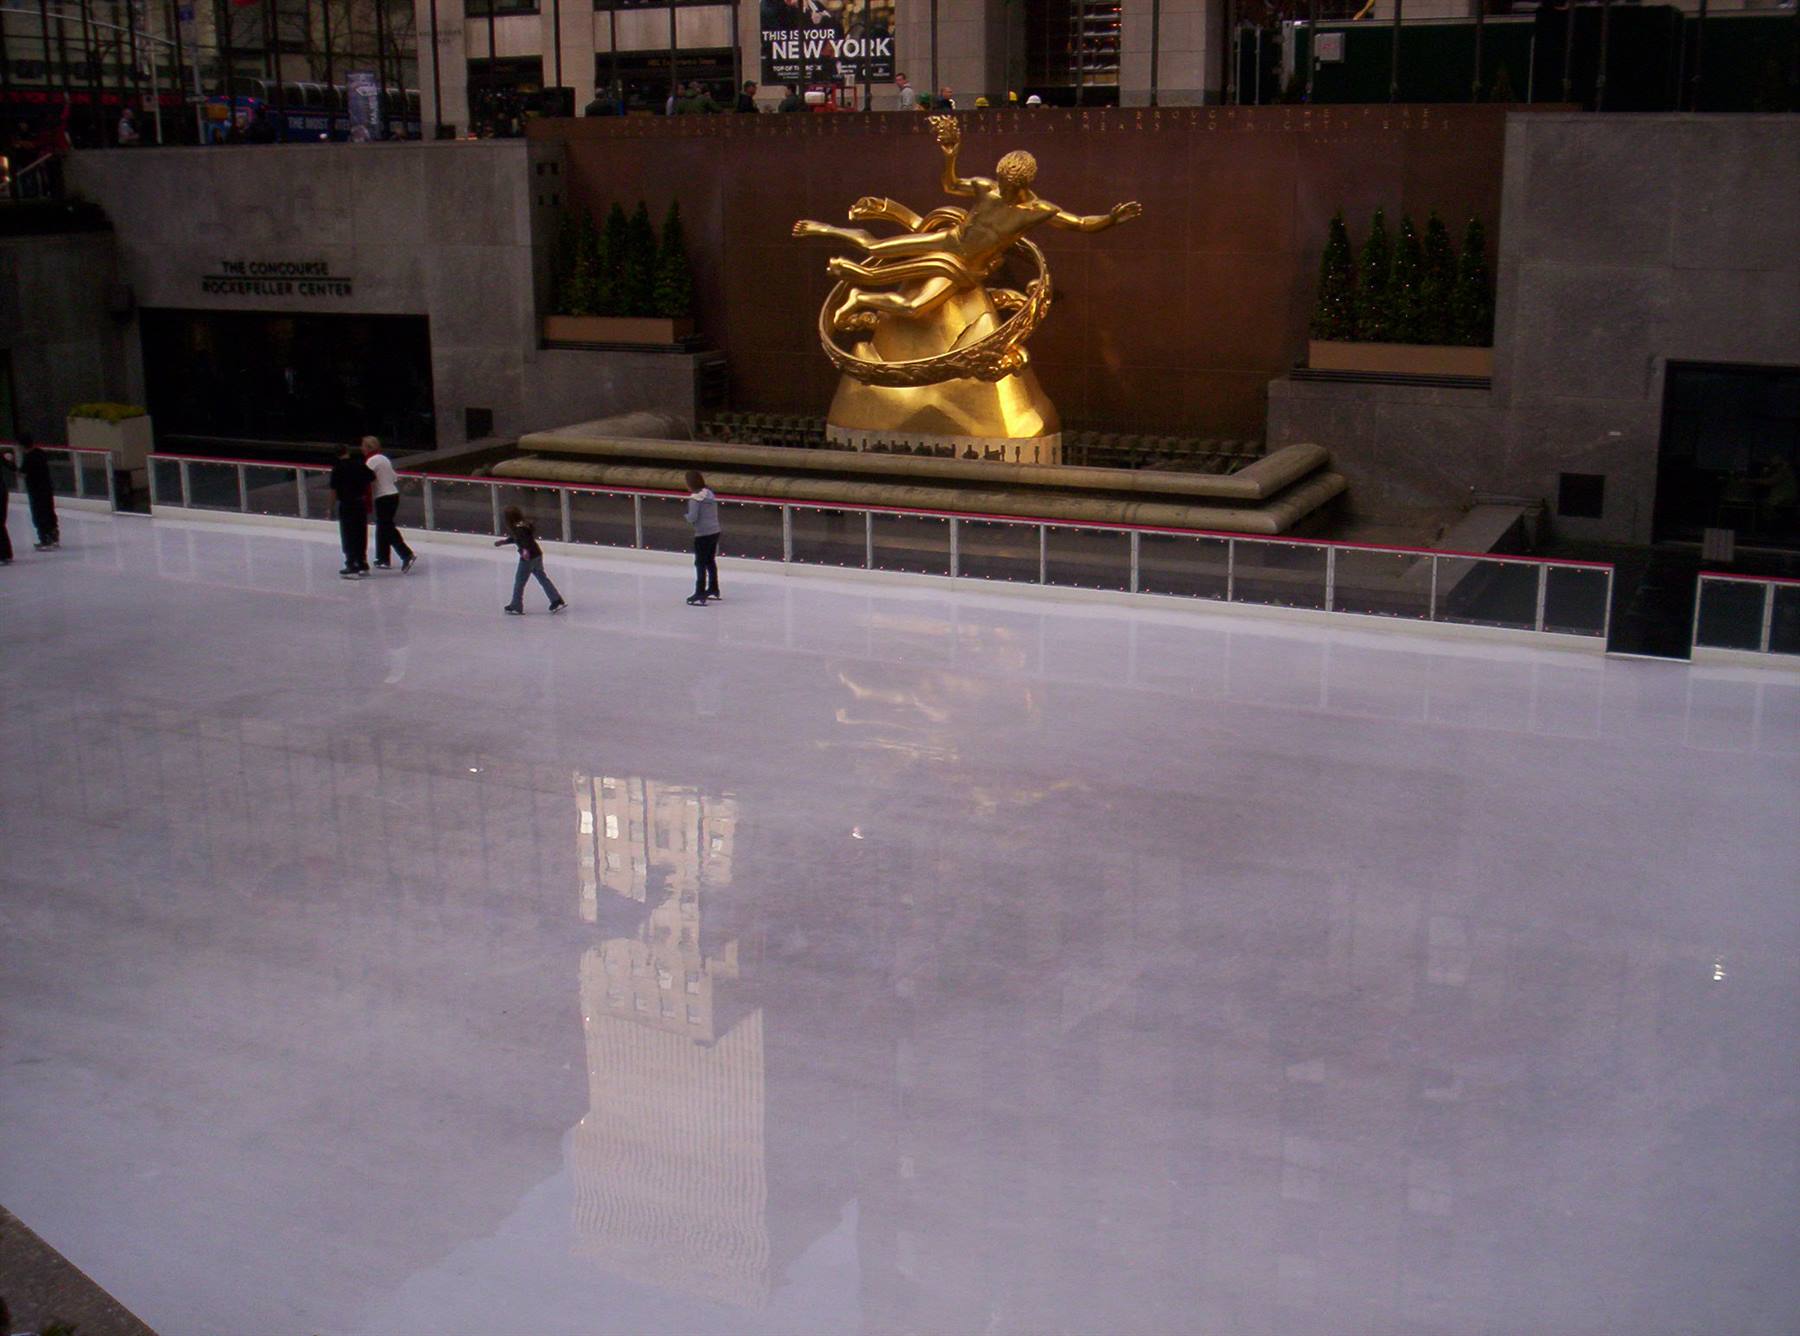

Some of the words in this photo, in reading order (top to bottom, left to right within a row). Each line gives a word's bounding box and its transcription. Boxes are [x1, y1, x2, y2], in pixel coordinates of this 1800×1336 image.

[762, 31, 786, 41] THIS
[789, 30, 799, 40] IS
[803, 29, 835, 40] YOUR
[772, 41, 823, 59] NEW
[829, 37, 891, 58] YORK
[1063, 111, 1106, 120] ART
[1284, 107, 1330, 118] THE
[1189, 120, 1216, 131] TO
[222, 261, 245, 274] THE
[249, 262, 329, 275] CONCOURSE
[202, 280, 293, 295] ROCKEFELLER
[298, 282, 353, 296] CENTER
